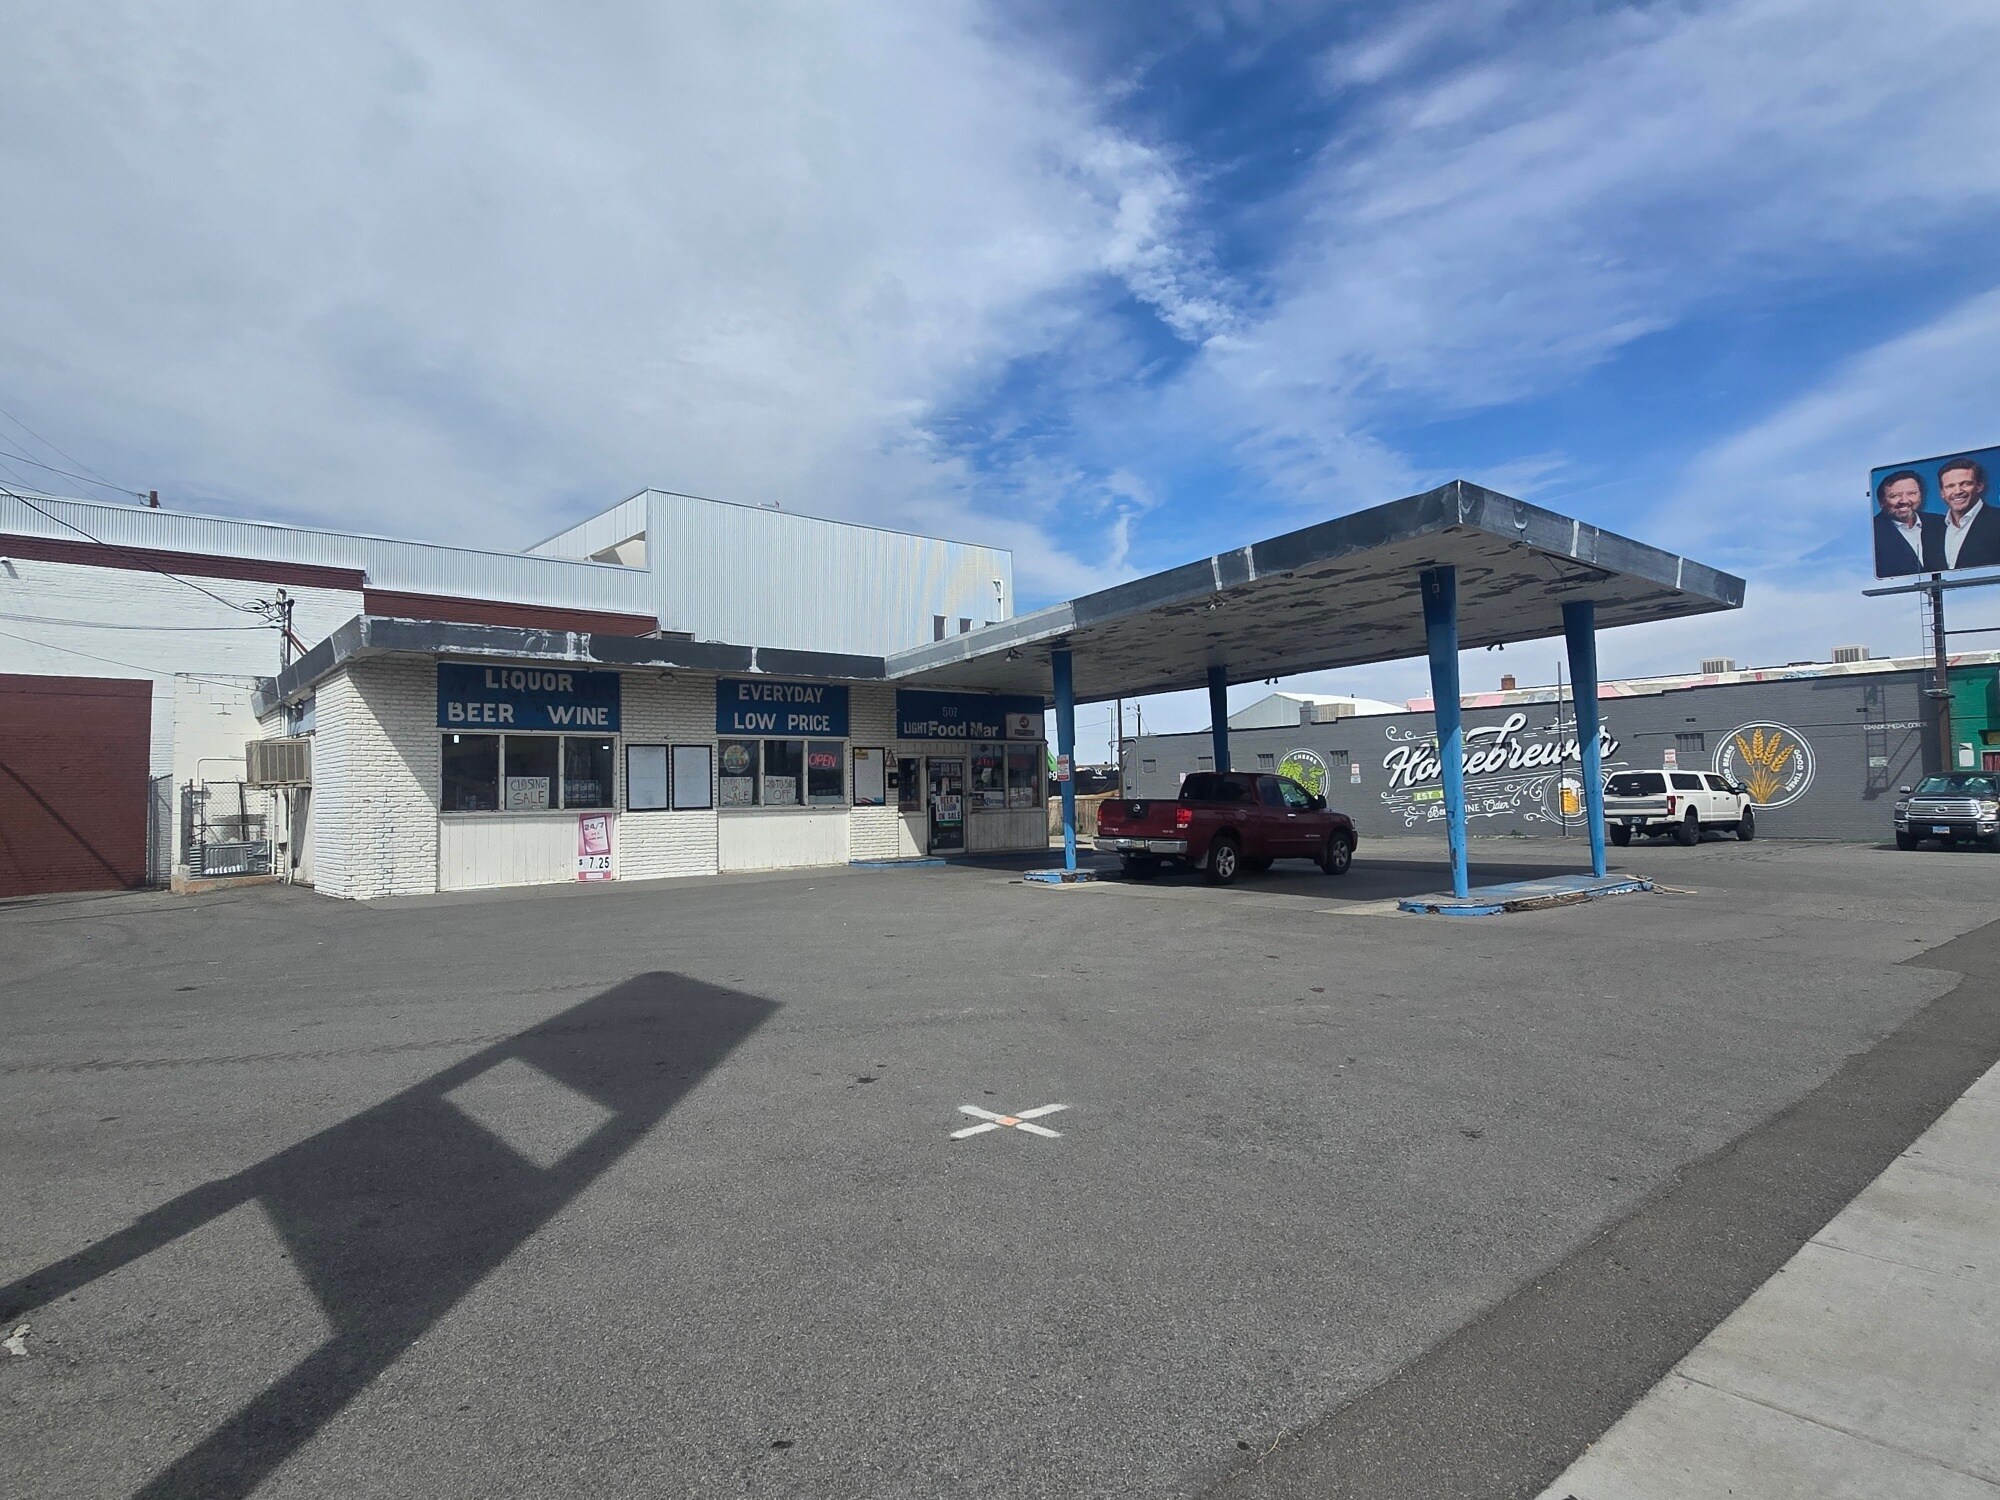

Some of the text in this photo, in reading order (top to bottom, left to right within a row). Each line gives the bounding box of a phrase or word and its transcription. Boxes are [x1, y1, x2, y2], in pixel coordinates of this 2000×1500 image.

[486, 669, 574, 692] LIQUOR
[738, 684, 824, 703] EVERYDAY
[448, 702, 609, 725] BEER WINE
[942, 707, 958, 717] 507
[734, 712, 831, 731] LOW PRICE
[904, 721, 928, 734] LIGHT
[928, 721, 966, 737] Food
[808, 752, 837, 769] OPEN
[1722, 745, 1738, 788] GOOD BEERS
[1785, 749, 1804, 792] GOOD TIMES
[511, 778, 548, 791] CLOSING
[512, 791, 545, 804] SALE
[723, 791, 751, 804] SALE
[773, 789, 792, 799] OFF
[1464, 802, 1481, 812] INE
[584, 821, 605, 831] 24/7
[589, 857, 610, 869] 7.25
